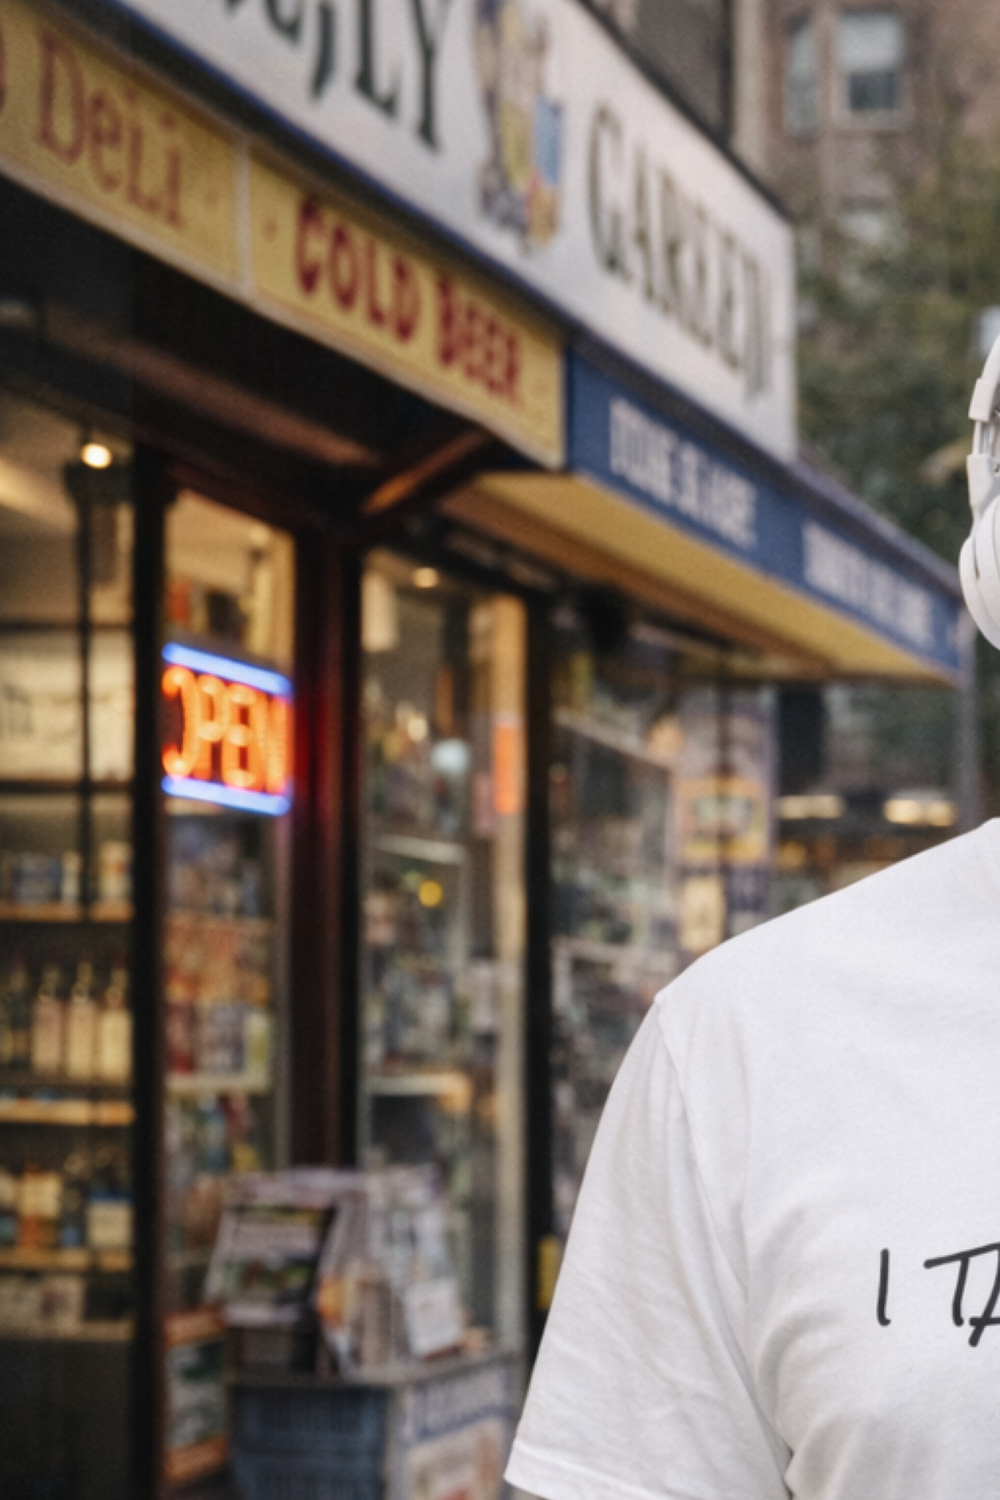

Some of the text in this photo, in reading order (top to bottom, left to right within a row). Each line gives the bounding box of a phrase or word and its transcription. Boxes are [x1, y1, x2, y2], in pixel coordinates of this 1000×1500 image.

[296, 196, 524, 406] COLD BEER
[876, 1248, 892, 1327] I
